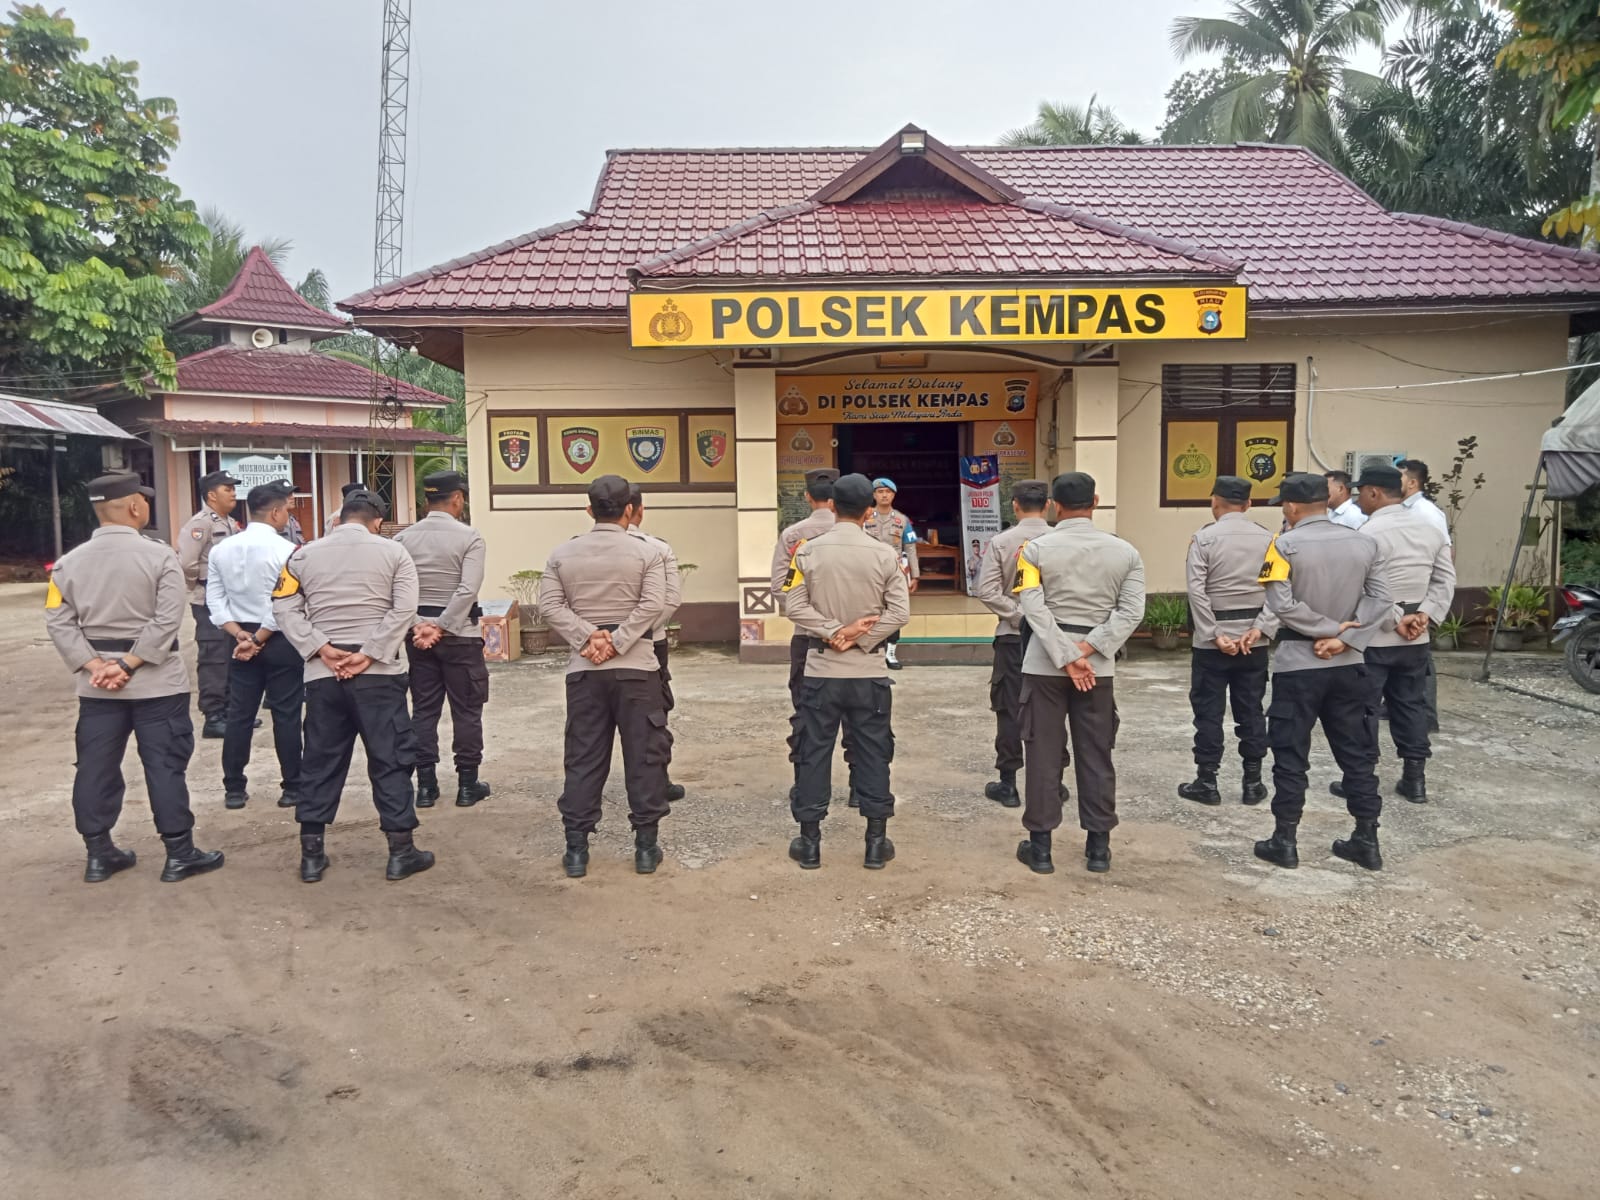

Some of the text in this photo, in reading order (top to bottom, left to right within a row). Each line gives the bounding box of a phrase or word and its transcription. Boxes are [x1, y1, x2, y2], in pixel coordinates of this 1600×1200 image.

[712, 294, 1166, 338] POLSEK KEMPAS
[844, 377, 964, 392] Selamat Datang
[818, 393, 989, 409] DI POLSEK KEMPAS
[972, 498, 989, 507] 110
